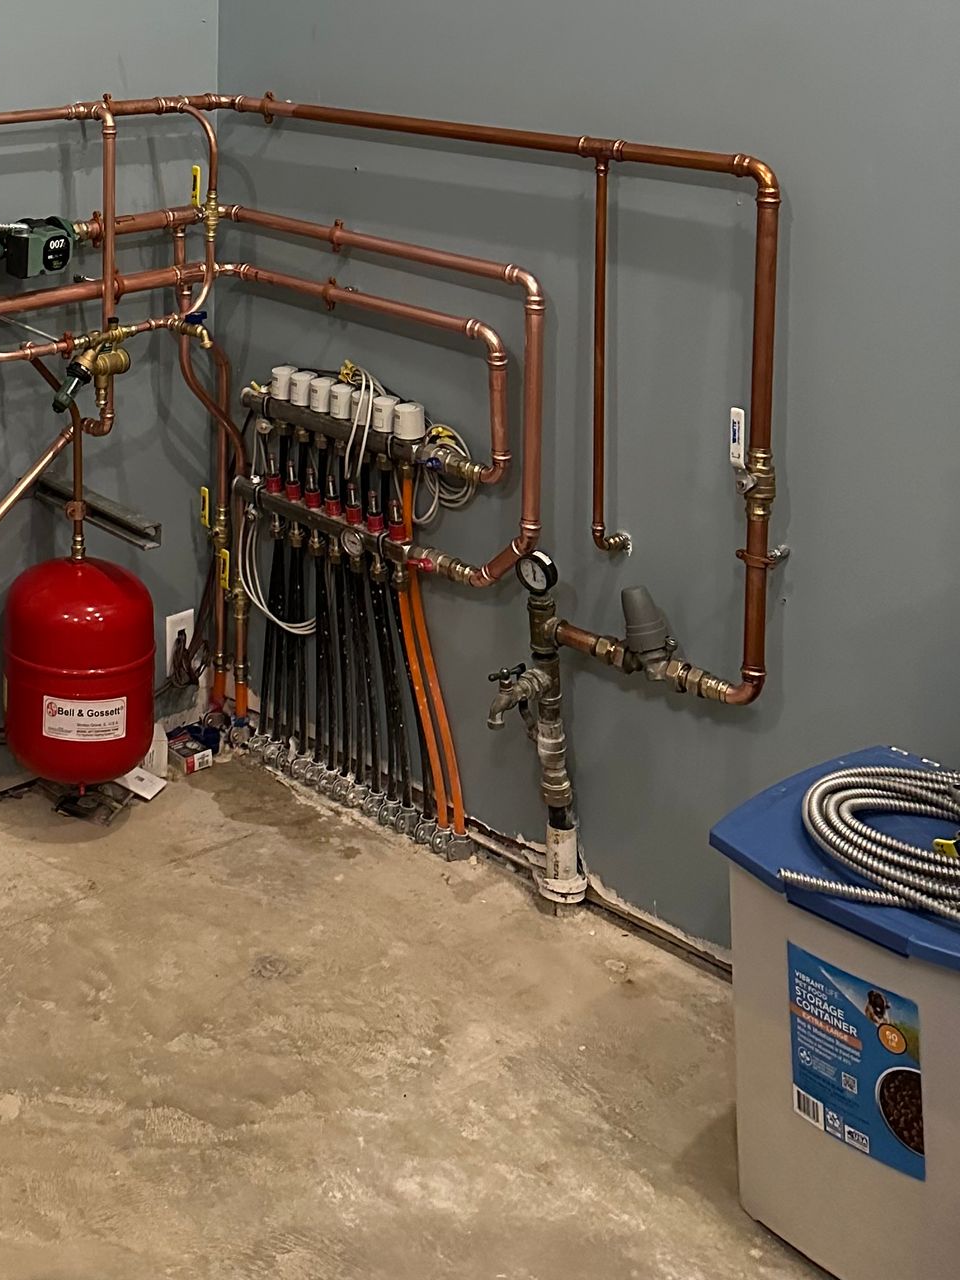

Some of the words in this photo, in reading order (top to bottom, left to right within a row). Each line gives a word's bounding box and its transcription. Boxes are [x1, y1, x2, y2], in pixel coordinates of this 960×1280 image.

[57, 706, 75, 717] Bell
[77, 709, 84, 717] &
[86, 706, 121, 718] Gossett
[794, 968, 825, 991] VIBRANT
[795, 977, 807, 989] PET
[808, 985, 828, 1001] FOOD
[795, 986, 845, 1021] STORAGE
[796, 996, 858, 1037] CONTAINER
